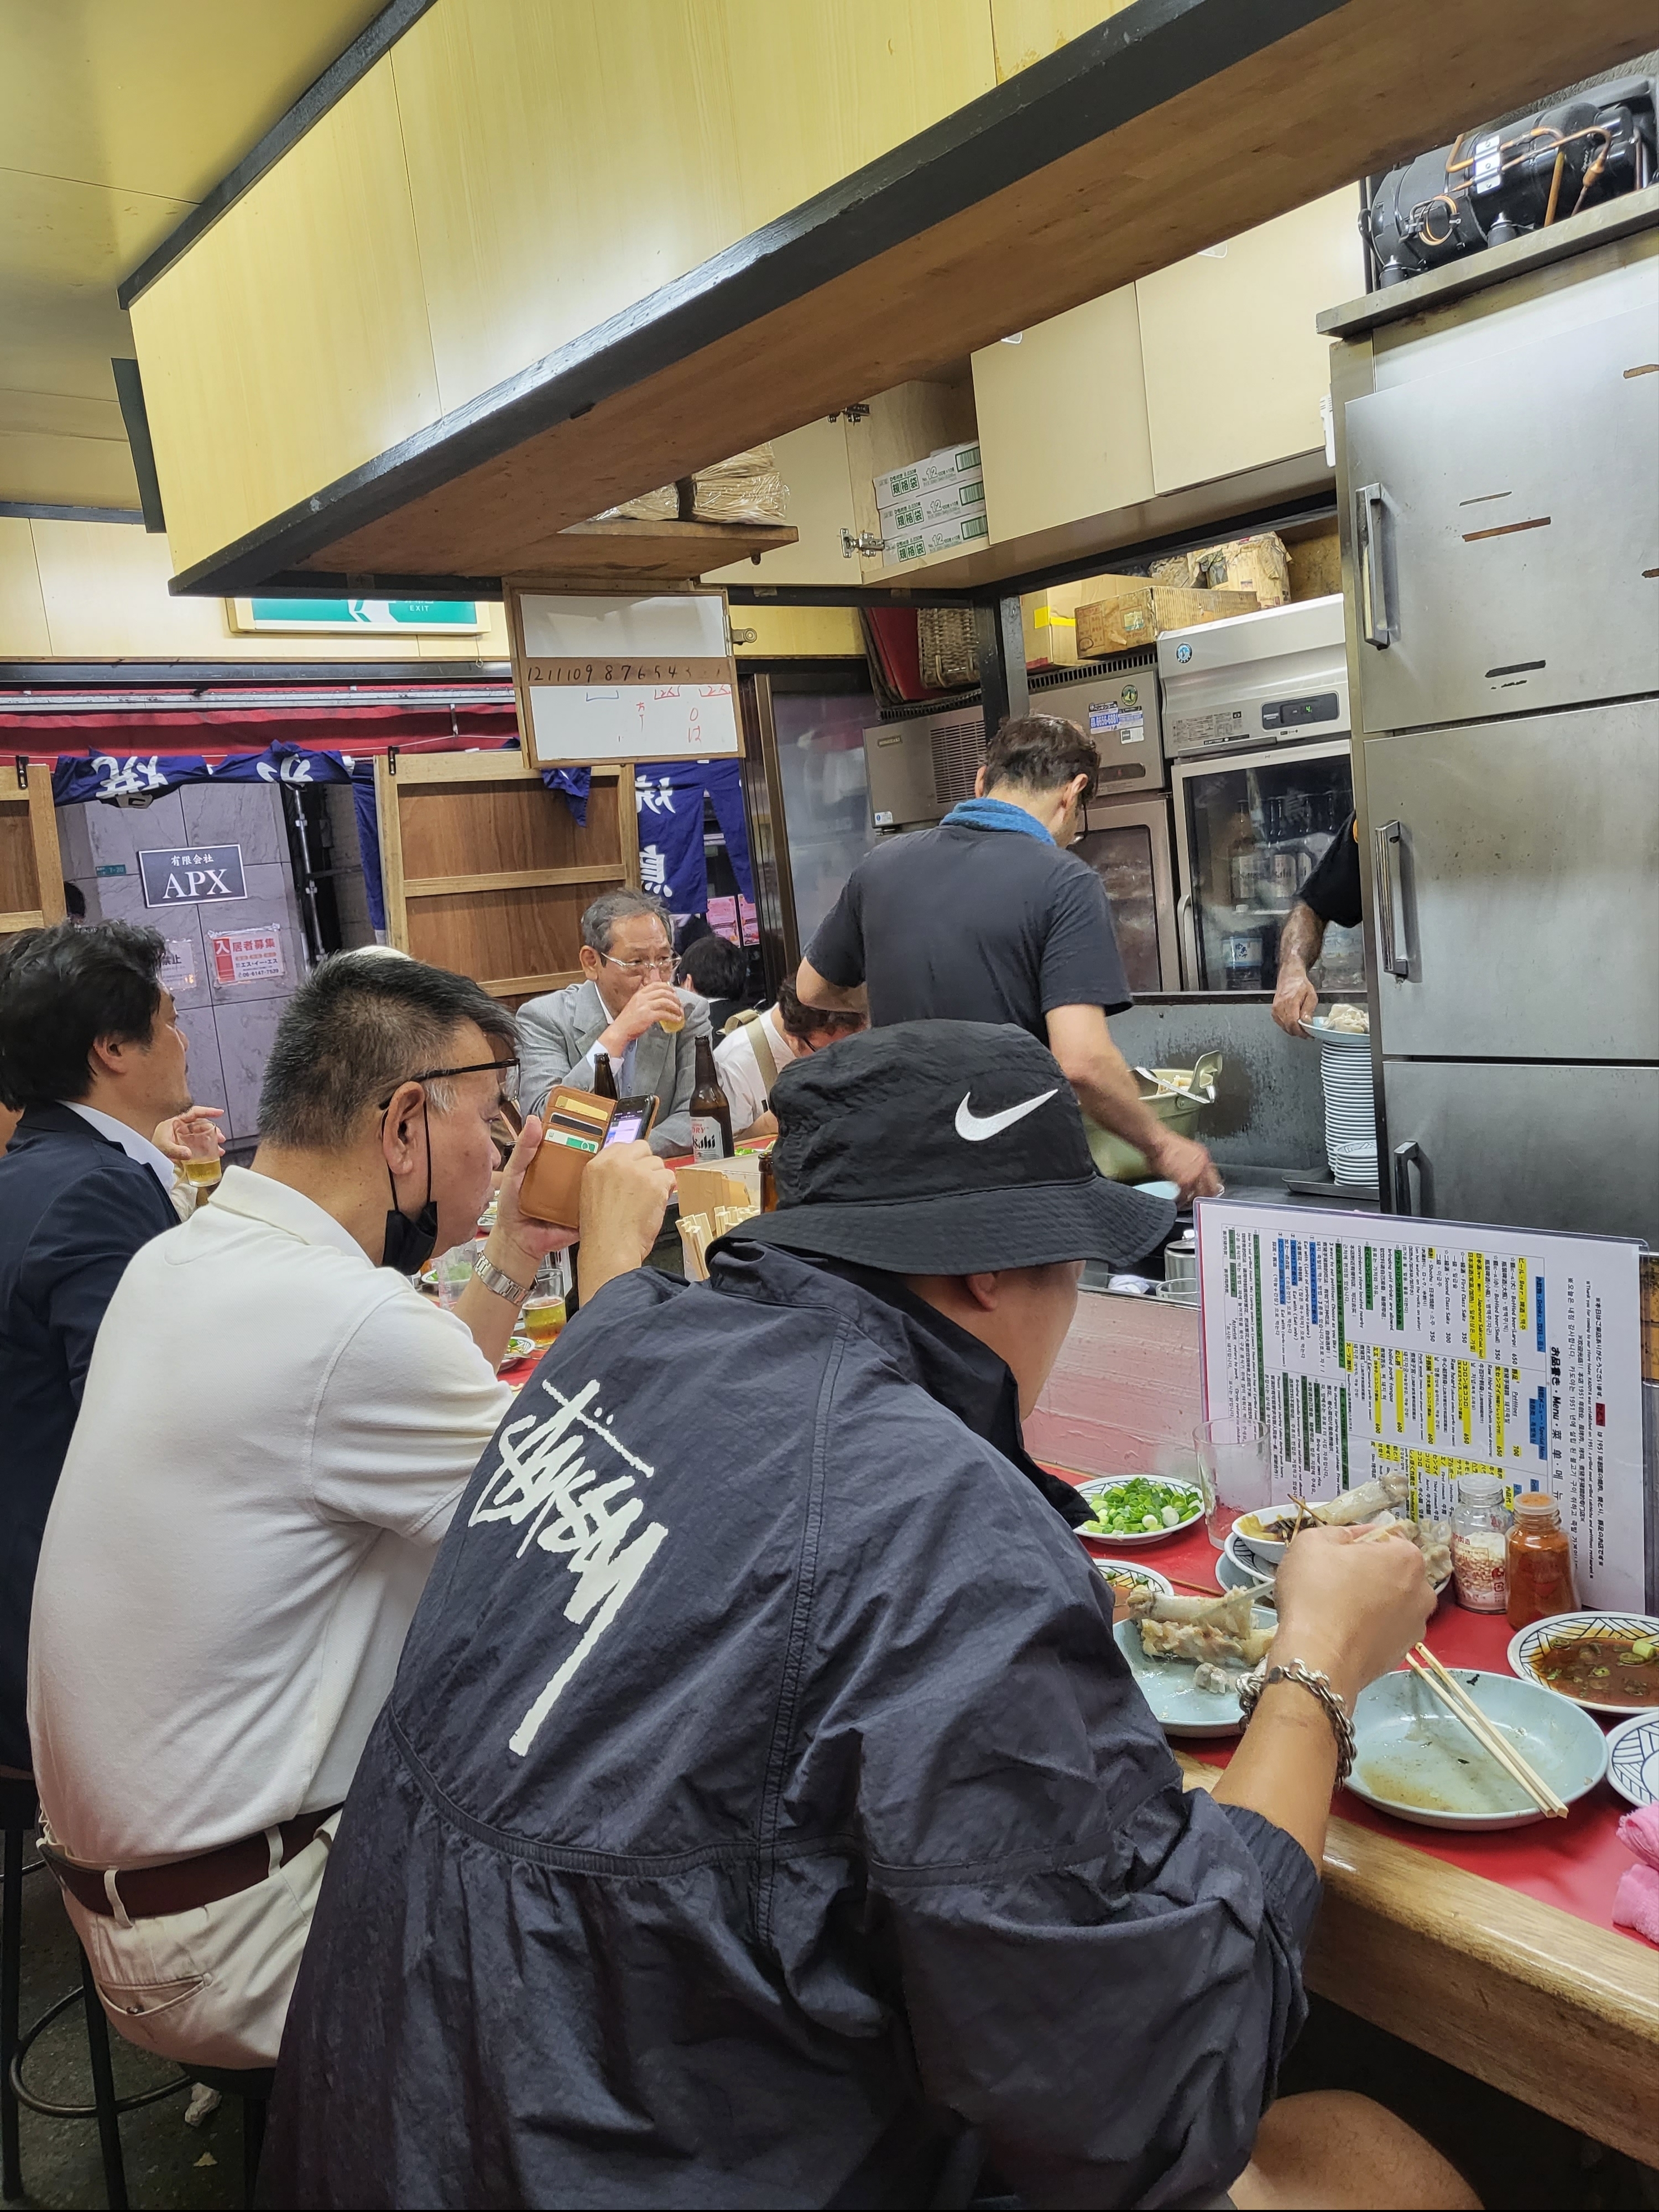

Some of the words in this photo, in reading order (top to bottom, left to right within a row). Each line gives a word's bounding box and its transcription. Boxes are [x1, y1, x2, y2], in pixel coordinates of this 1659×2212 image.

[926, 466, 938, 479] 12
[893, 477, 918, 494] 規格袋
[931, 499, 942, 513] 12
[897, 510, 922, 527] 規格袋
[932, 532, 945, 545] 12
[899, 543, 925, 560] 規格袋
[528, 667, 543, 681] 12
[568, 669, 581, 681] 10
[586, 665, 592, 682] 9
[606, 665, 612, 681] 8
[622, 665, 631, 681] 7
[638, 666, 645, 677] 6
[669, 666, 677, 677] 4
[170, 854, 215, 866] 有限会社
[163, 869, 232, 899] APX
[1568, 1307, 1574, 1320] 내점
[1577, 1371, 1584, 1384] 本店
[1569, 1414, 1575, 1427] 년에
[1569, 1431, 1576, 1443] 설립
[1570, 1480, 1577, 1493] 구이
